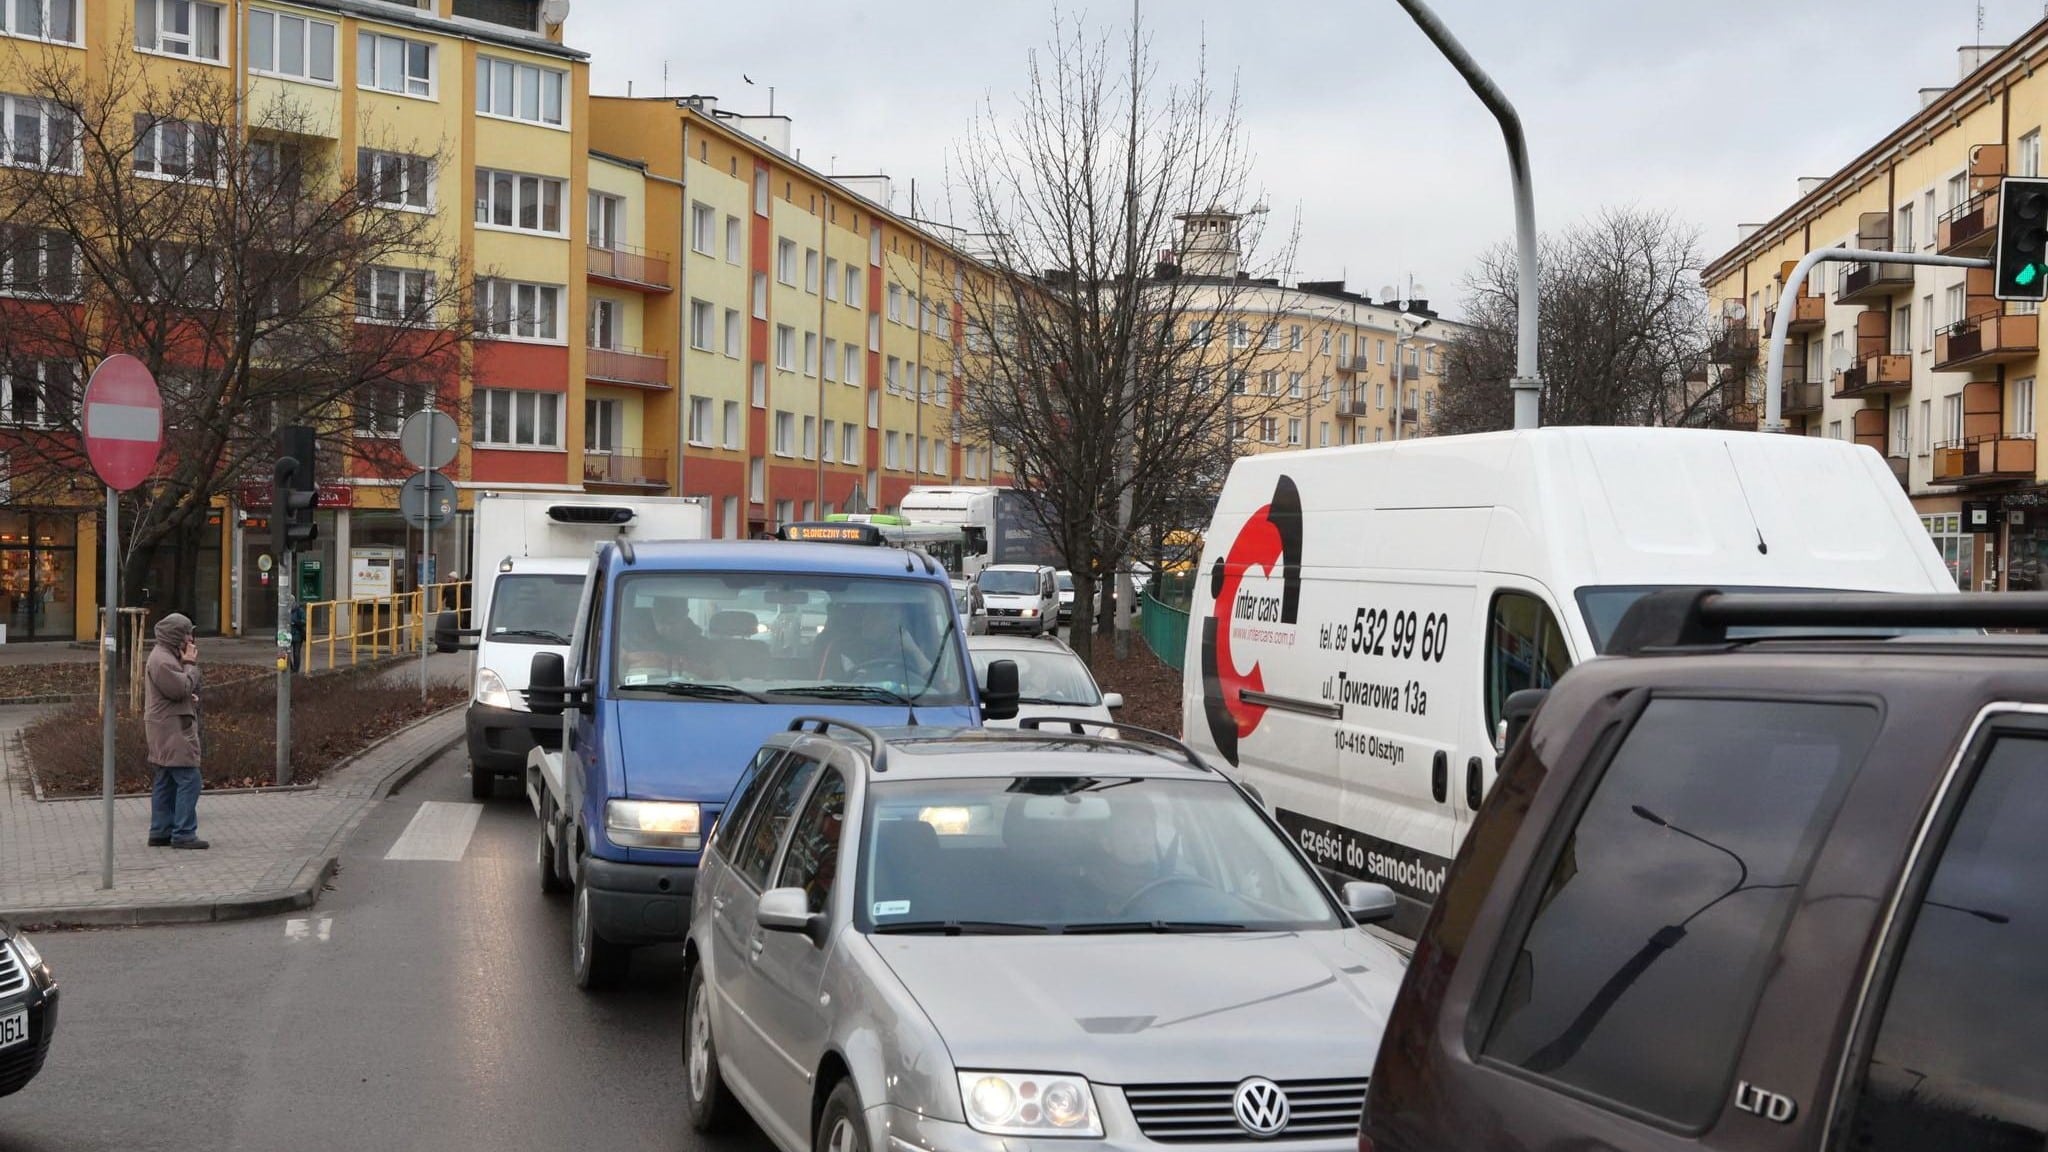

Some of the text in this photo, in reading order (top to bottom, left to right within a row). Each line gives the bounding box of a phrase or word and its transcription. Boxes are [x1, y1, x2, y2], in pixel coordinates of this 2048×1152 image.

[1235, 588, 1280, 623] inter cars
[1319, 607, 1448, 663] tel. 89 532 99 60
[1322, 671, 1427, 716] ul. Towarowa 13a
[1334, 729, 1404, 766] 10-416 Olsztyn
[1300, 828, 1343, 863] części
[1346, 838, 1364, 869] do
[1735, 1080, 1795, 1123] LTD
